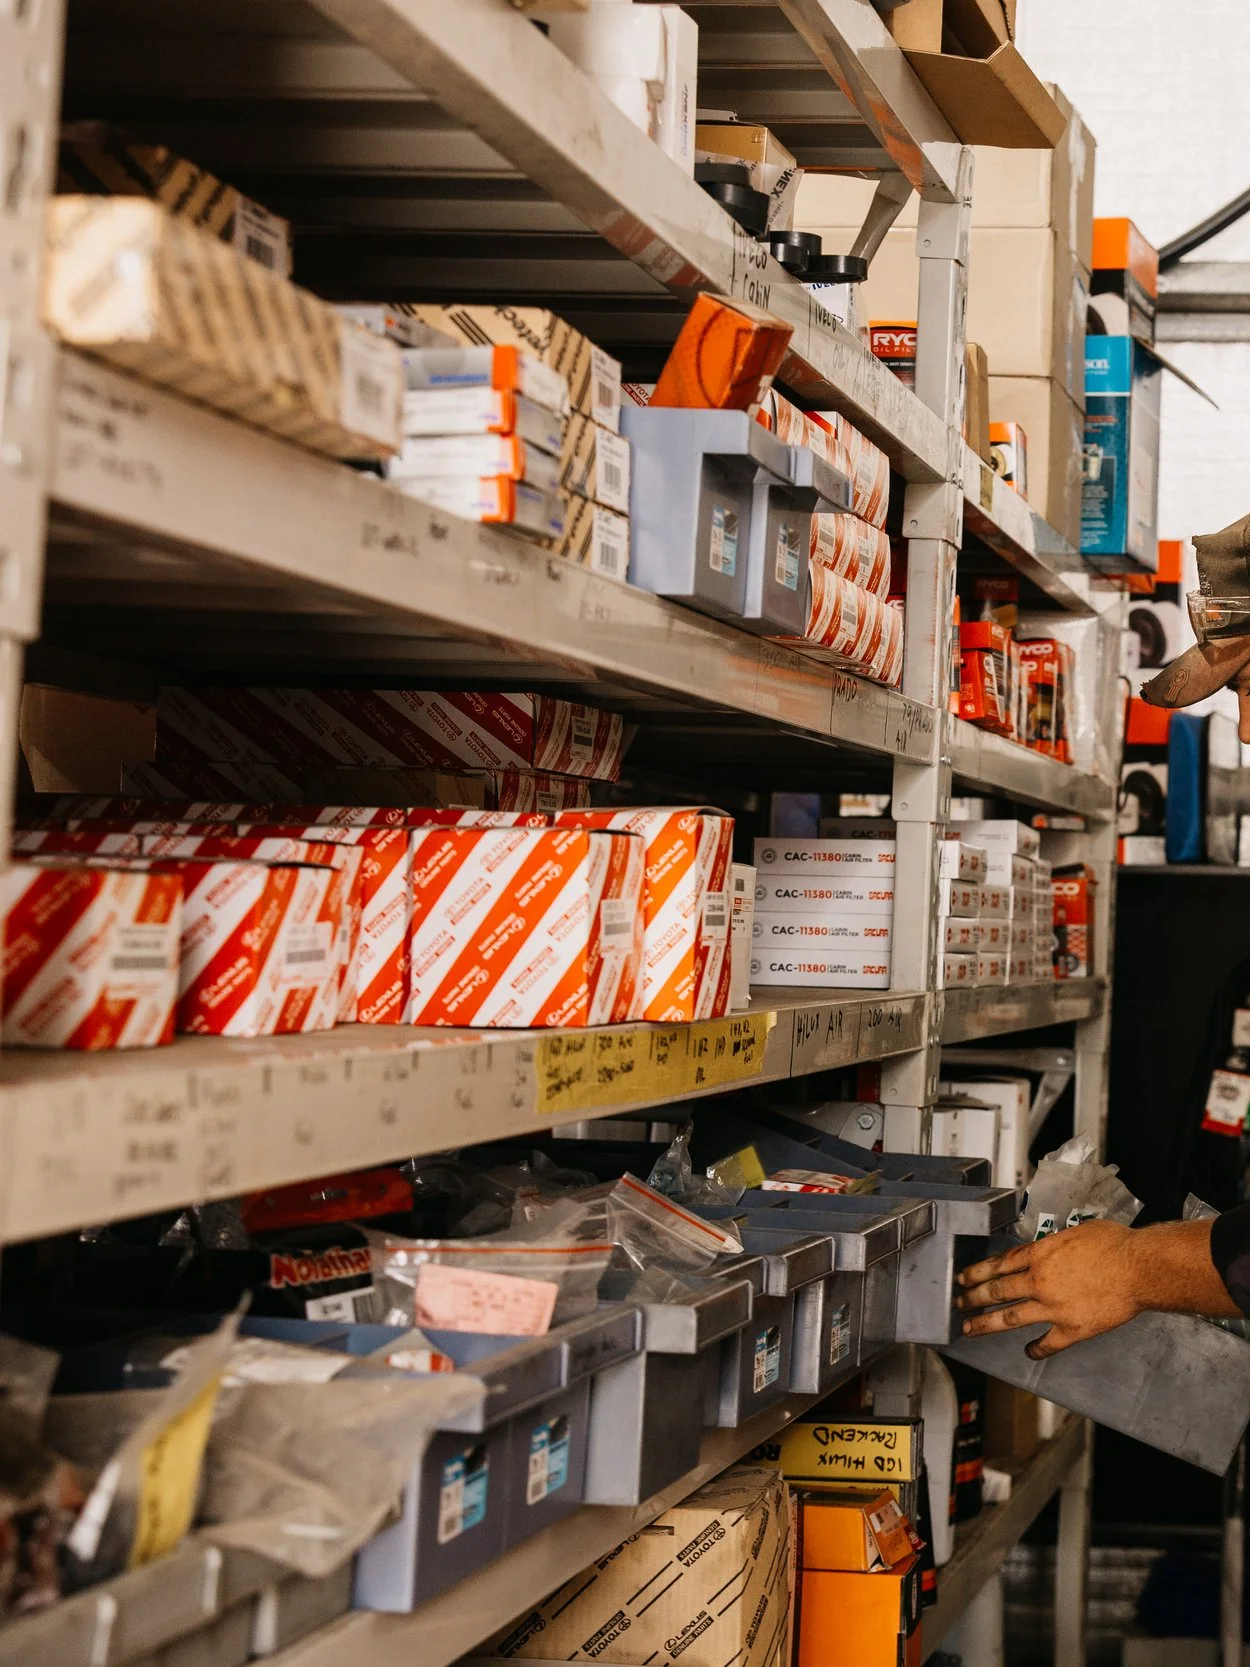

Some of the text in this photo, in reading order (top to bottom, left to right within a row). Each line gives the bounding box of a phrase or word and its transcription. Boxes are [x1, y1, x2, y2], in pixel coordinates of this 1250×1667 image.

[873, 333, 916, 346] RYC
[784, 852, 842, 862] CAC-11380
[775, 889, 832, 899] CAC-11380
[1052, 882, 1080, 895] CO
[772, 926, 828, 936] CAC-11380
[770, 963, 826, 973] CAC-11380
[826, 1010, 843, 1044] AIR
[817, 1452, 865, 1471] HILUX
[697, 1520, 719, 1545] GENUINE
[683, 1537, 716, 1568] TOYOTA
[600, 1610, 625, 1634] GENUINE
[676, 1610, 707, 1642] LEXUS
[588, 1629, 621, 1658] TOYOTA
[672, 1631, 696, 1657] GENUINE
